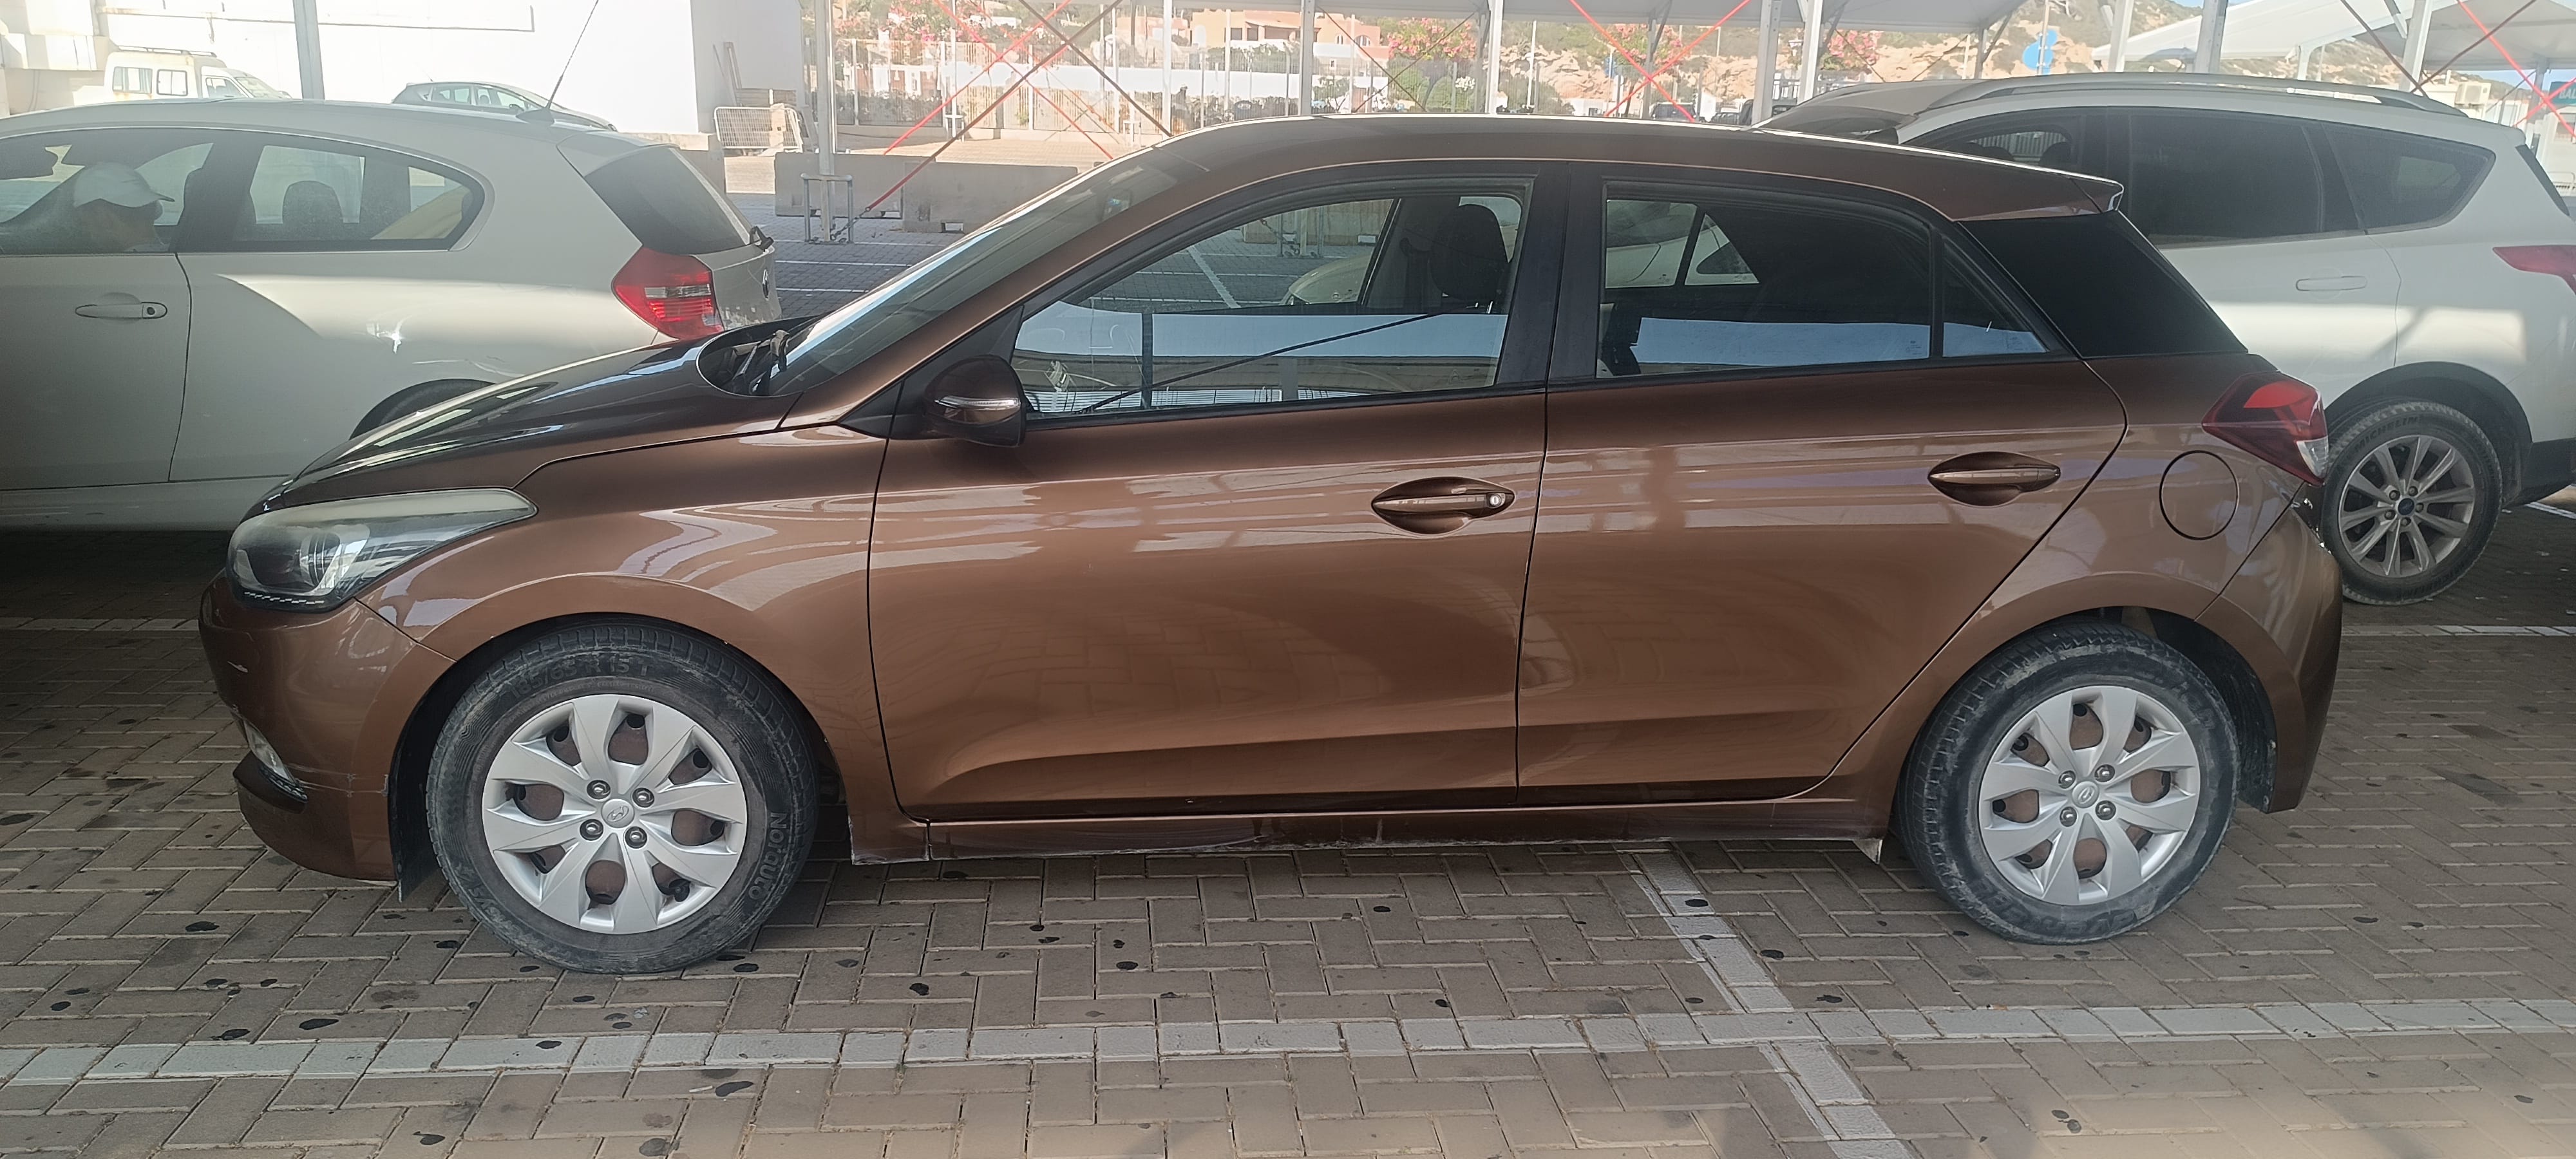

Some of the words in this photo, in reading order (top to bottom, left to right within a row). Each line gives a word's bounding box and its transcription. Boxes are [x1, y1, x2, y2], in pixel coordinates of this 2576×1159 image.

[512, 661, 577, 699] 185/65
[585, 657, 601, 674] R
[609, 655, 630, 674] 15
[748, 812, 787, 900] Norauto
